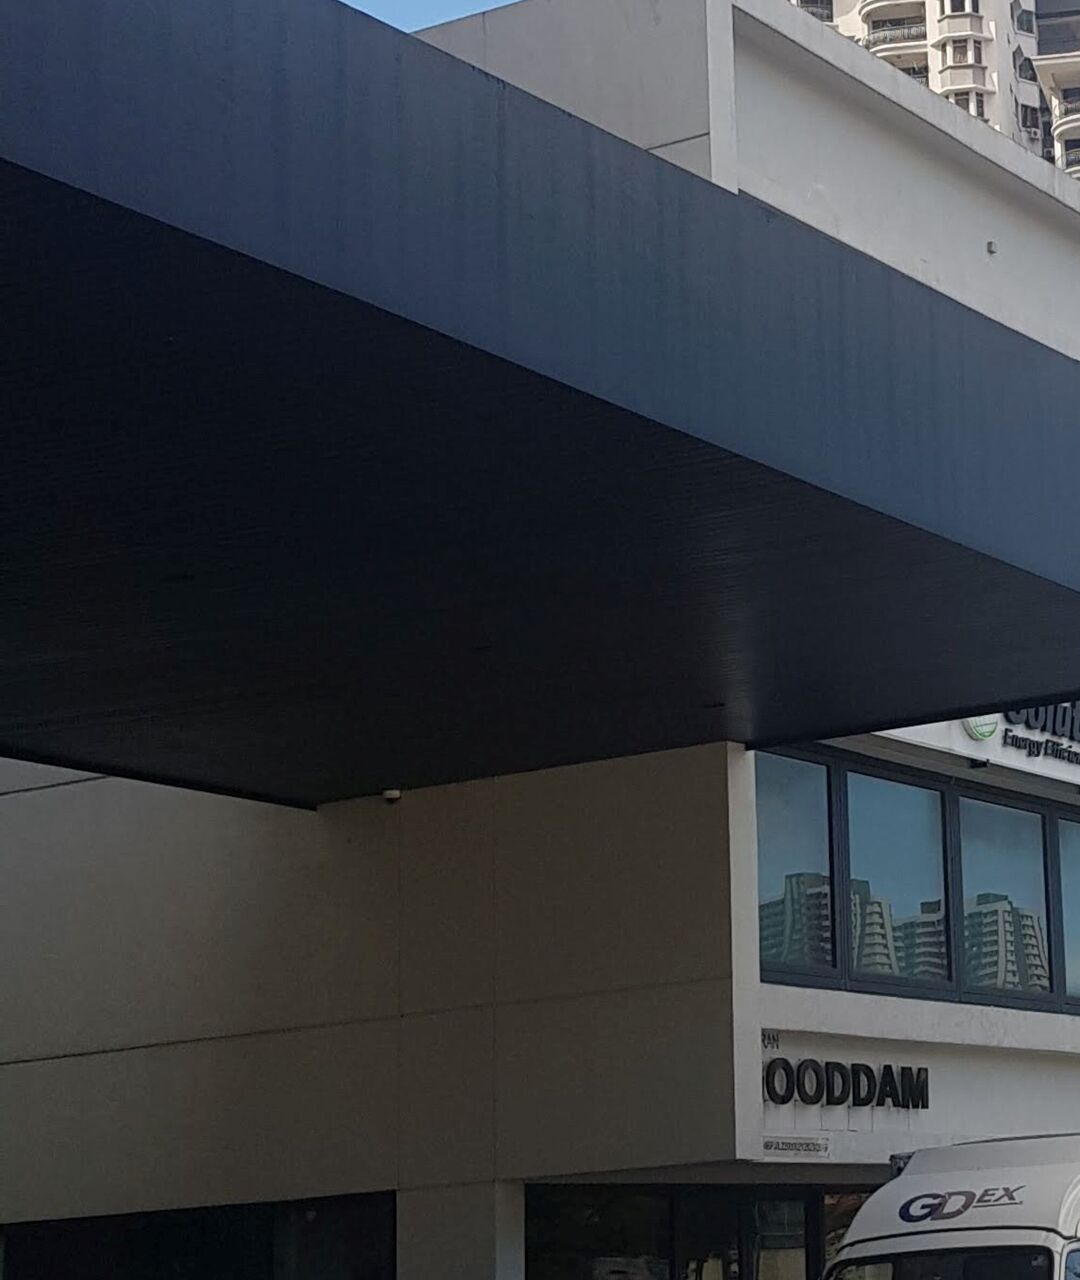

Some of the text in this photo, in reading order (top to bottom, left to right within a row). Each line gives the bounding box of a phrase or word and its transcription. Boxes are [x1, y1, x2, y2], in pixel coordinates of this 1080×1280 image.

[1002, 728, 1044, 759] Energy
[762, 1057, 930, 1110] OODDAM
[898, 1184, 1027, 1223] GDEX
